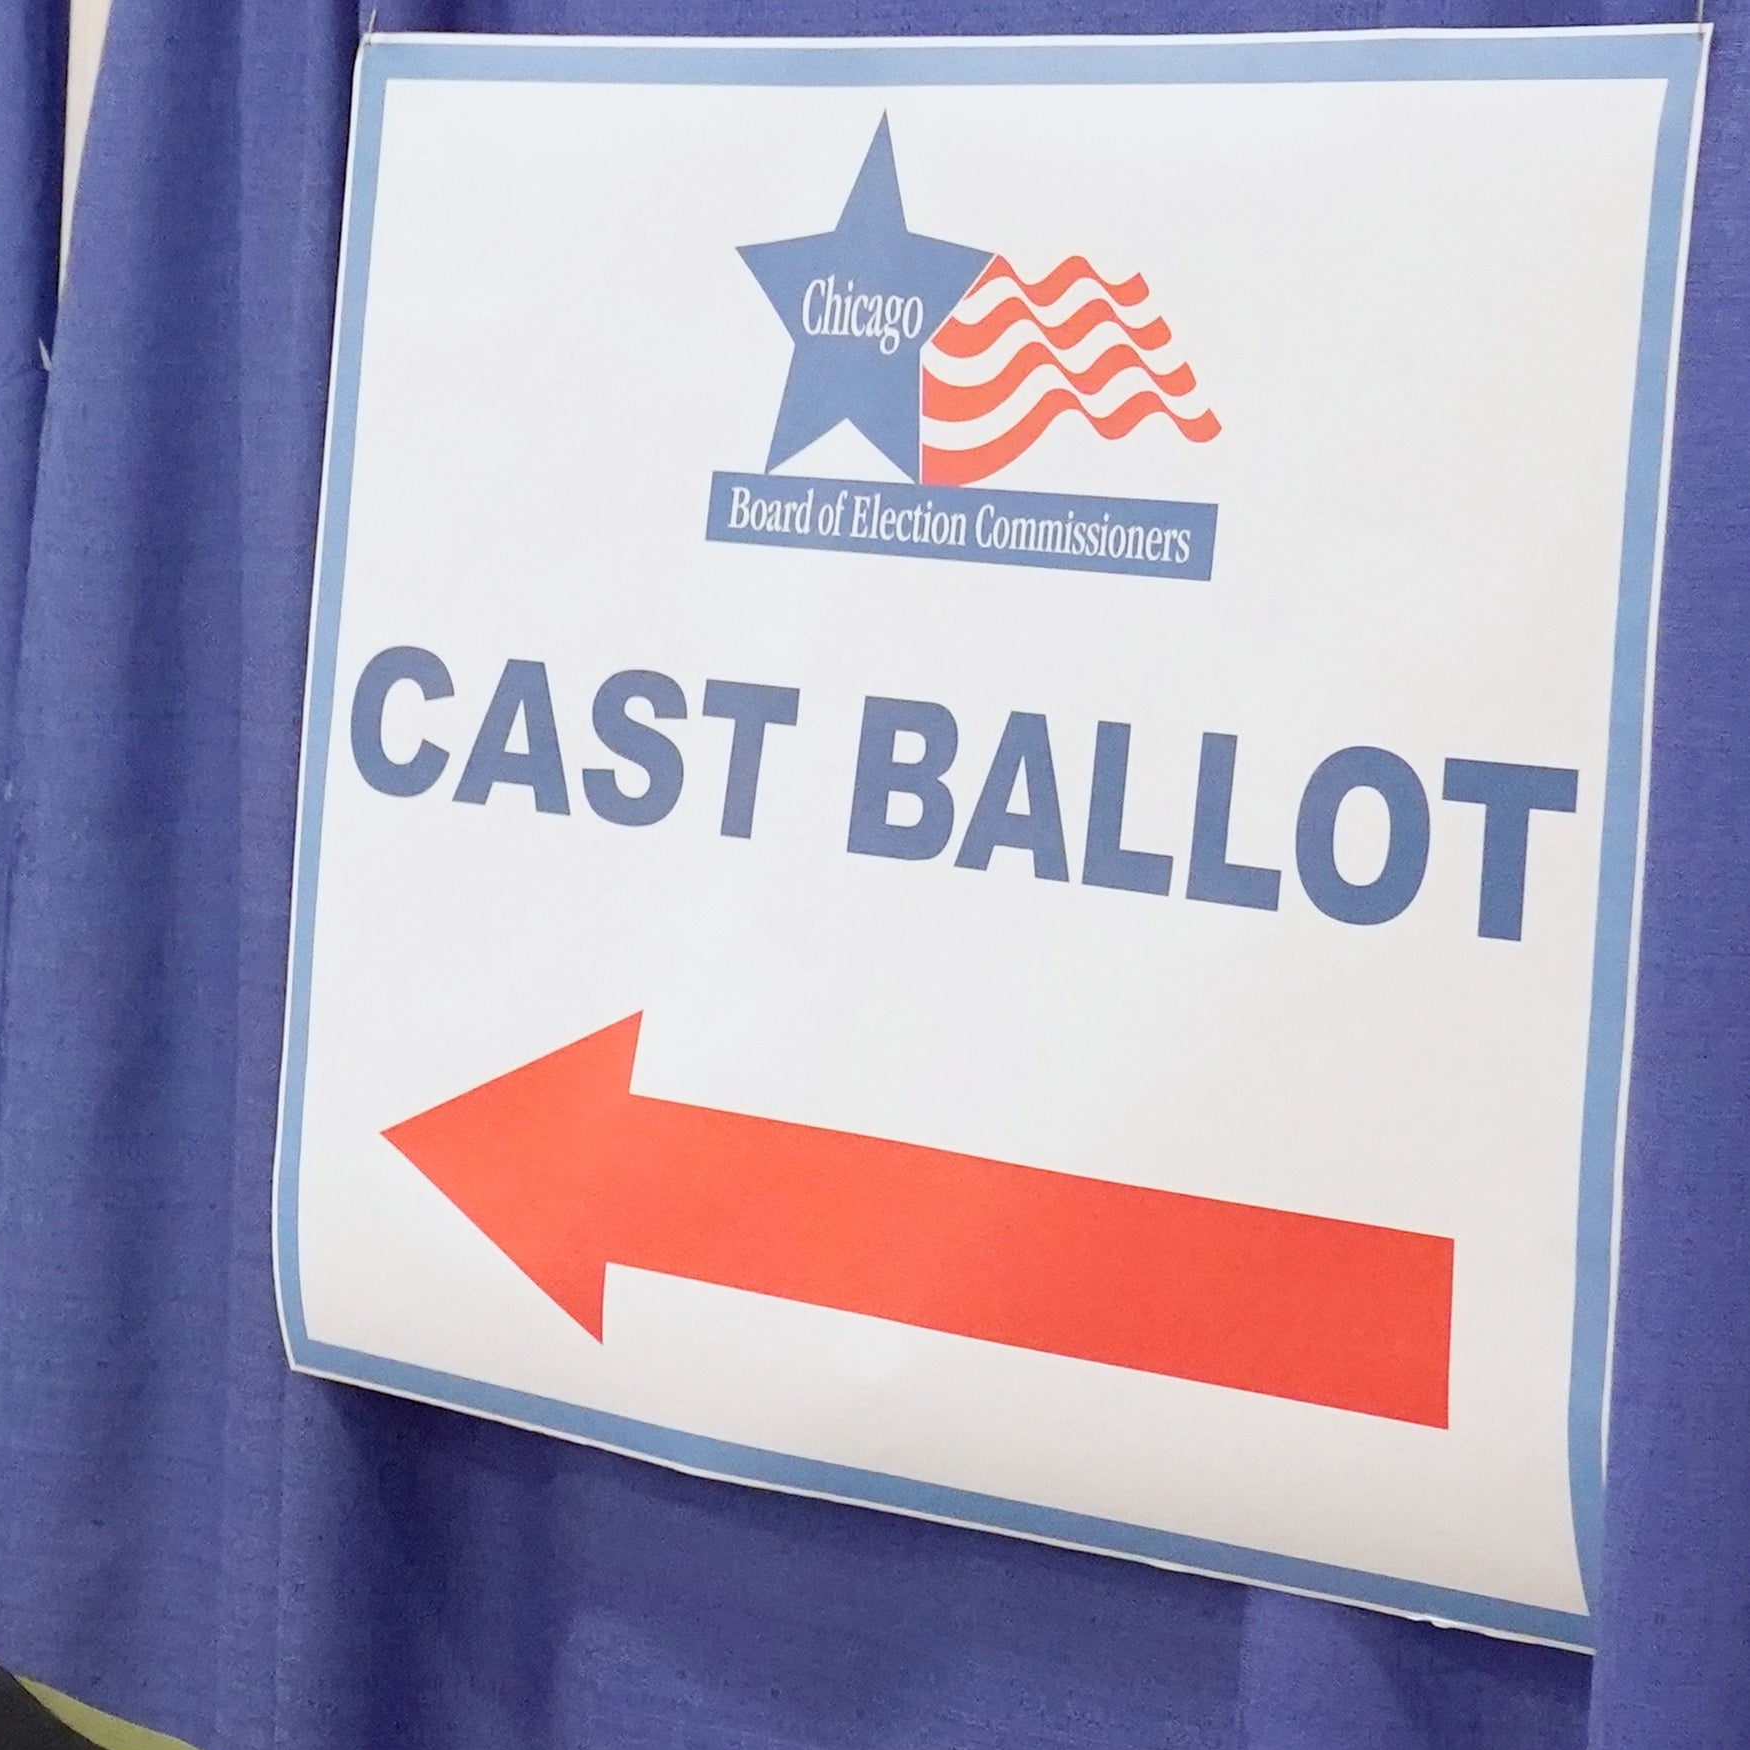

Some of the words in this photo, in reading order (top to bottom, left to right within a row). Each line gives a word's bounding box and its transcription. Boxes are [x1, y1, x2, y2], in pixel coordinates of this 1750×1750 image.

[802, 274, 924, 355] Chicago
[728, 486, 815, 535] Board
[818, 489, 849, 537] of
[850, 493, 967, 547] Election
[975, 503, 1191, 564] Commissioners
[350, 646, 801, 839] CAST
[846, 695, 1579, 942] BALLOT
